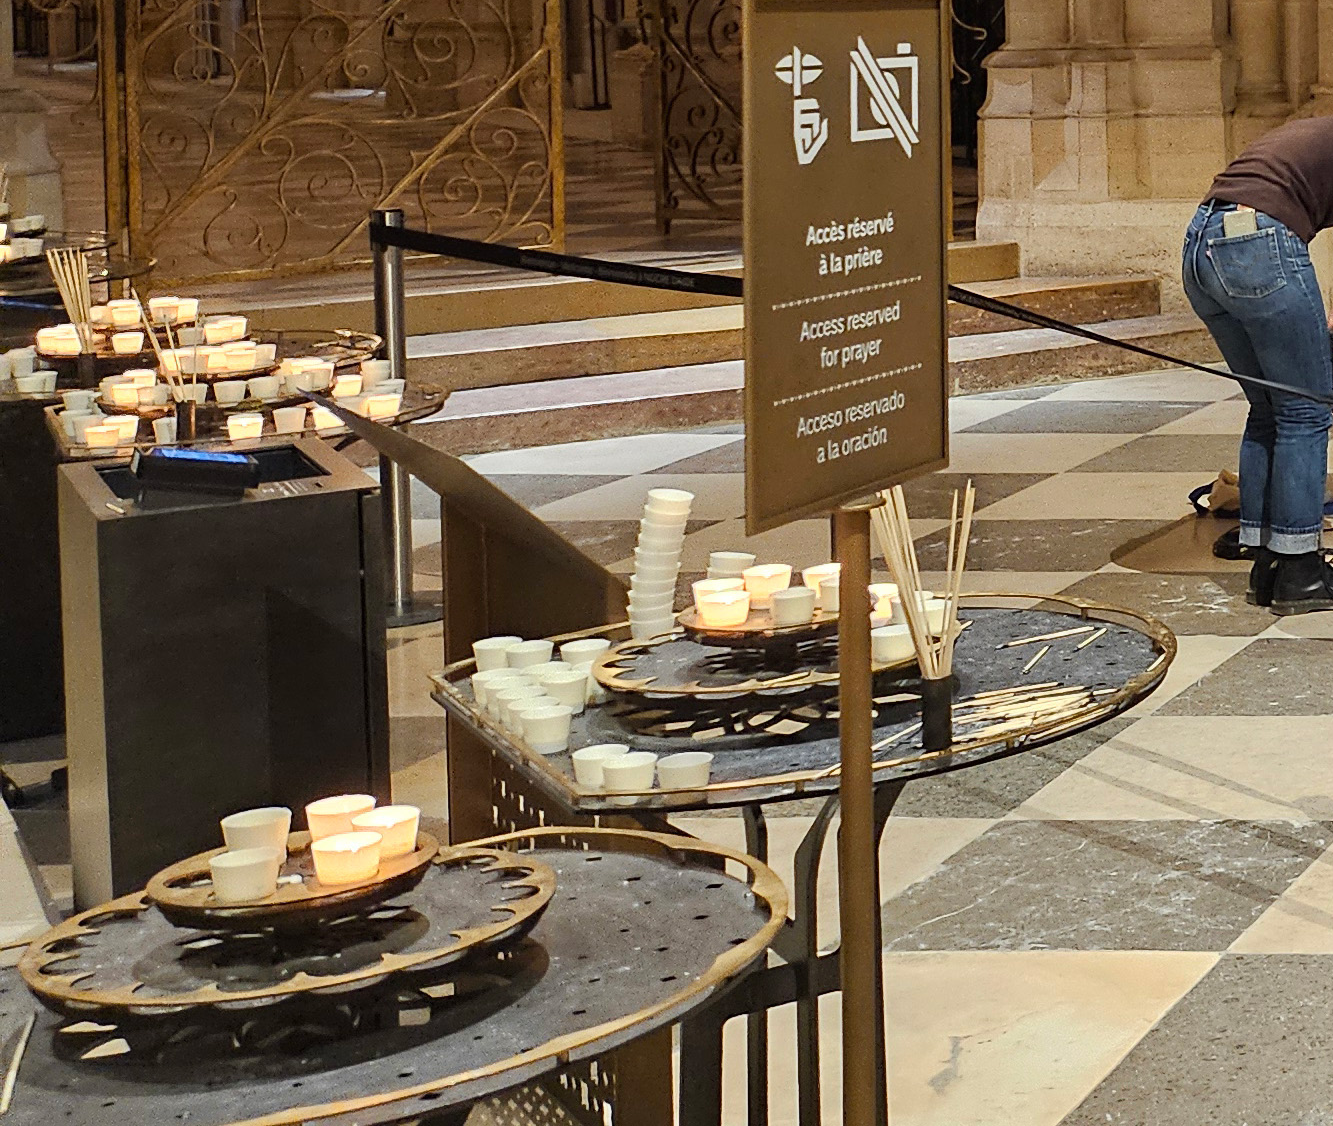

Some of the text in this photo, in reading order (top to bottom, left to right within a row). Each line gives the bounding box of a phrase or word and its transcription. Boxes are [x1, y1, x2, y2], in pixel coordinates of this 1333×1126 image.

[805, 211, 894, 246] Accès réservé
[818, 245, 883, 276] à la prière
[799, 299, 900, 342] Access reserved
[820, 338, 882, 369] for prayer
[796, 389, 905, 438] Acceso reservado
[816, 425, 888, 464] a la oración
